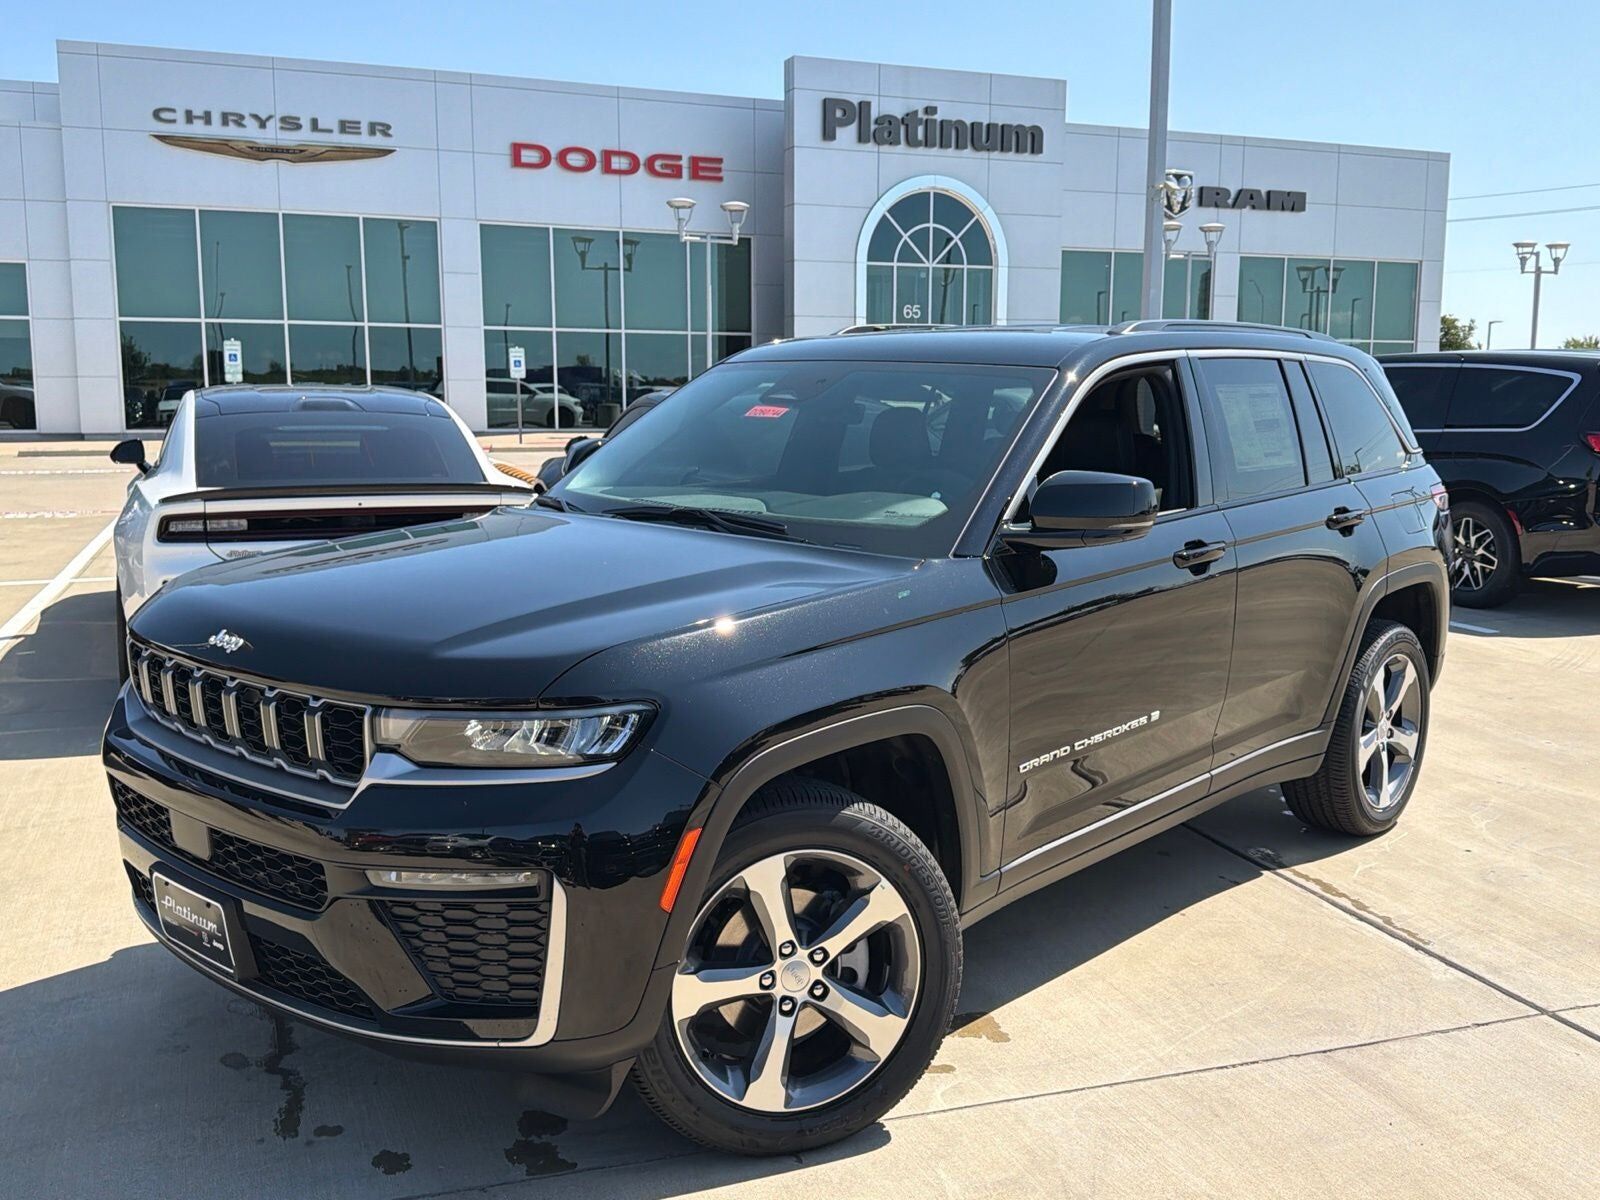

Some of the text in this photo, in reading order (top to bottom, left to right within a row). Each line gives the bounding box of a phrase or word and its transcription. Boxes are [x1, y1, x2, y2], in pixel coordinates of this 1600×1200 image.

[152, 107, 393, 138] CHRYSLER
[822, 97, 1044, 155] Platinum
[510, 141, 724, 182] DODGE
[1198, 186, 1307, 212] RAM
[903, 304, 921, 319] 65
[208, 629, 244, 653] Jeep
[1018, 715, 1149, 774] GRAND CHEROKEE
[866, 824, 951, 928] BRIDGESTONE
[161, 895, 222, 937] Platinum
